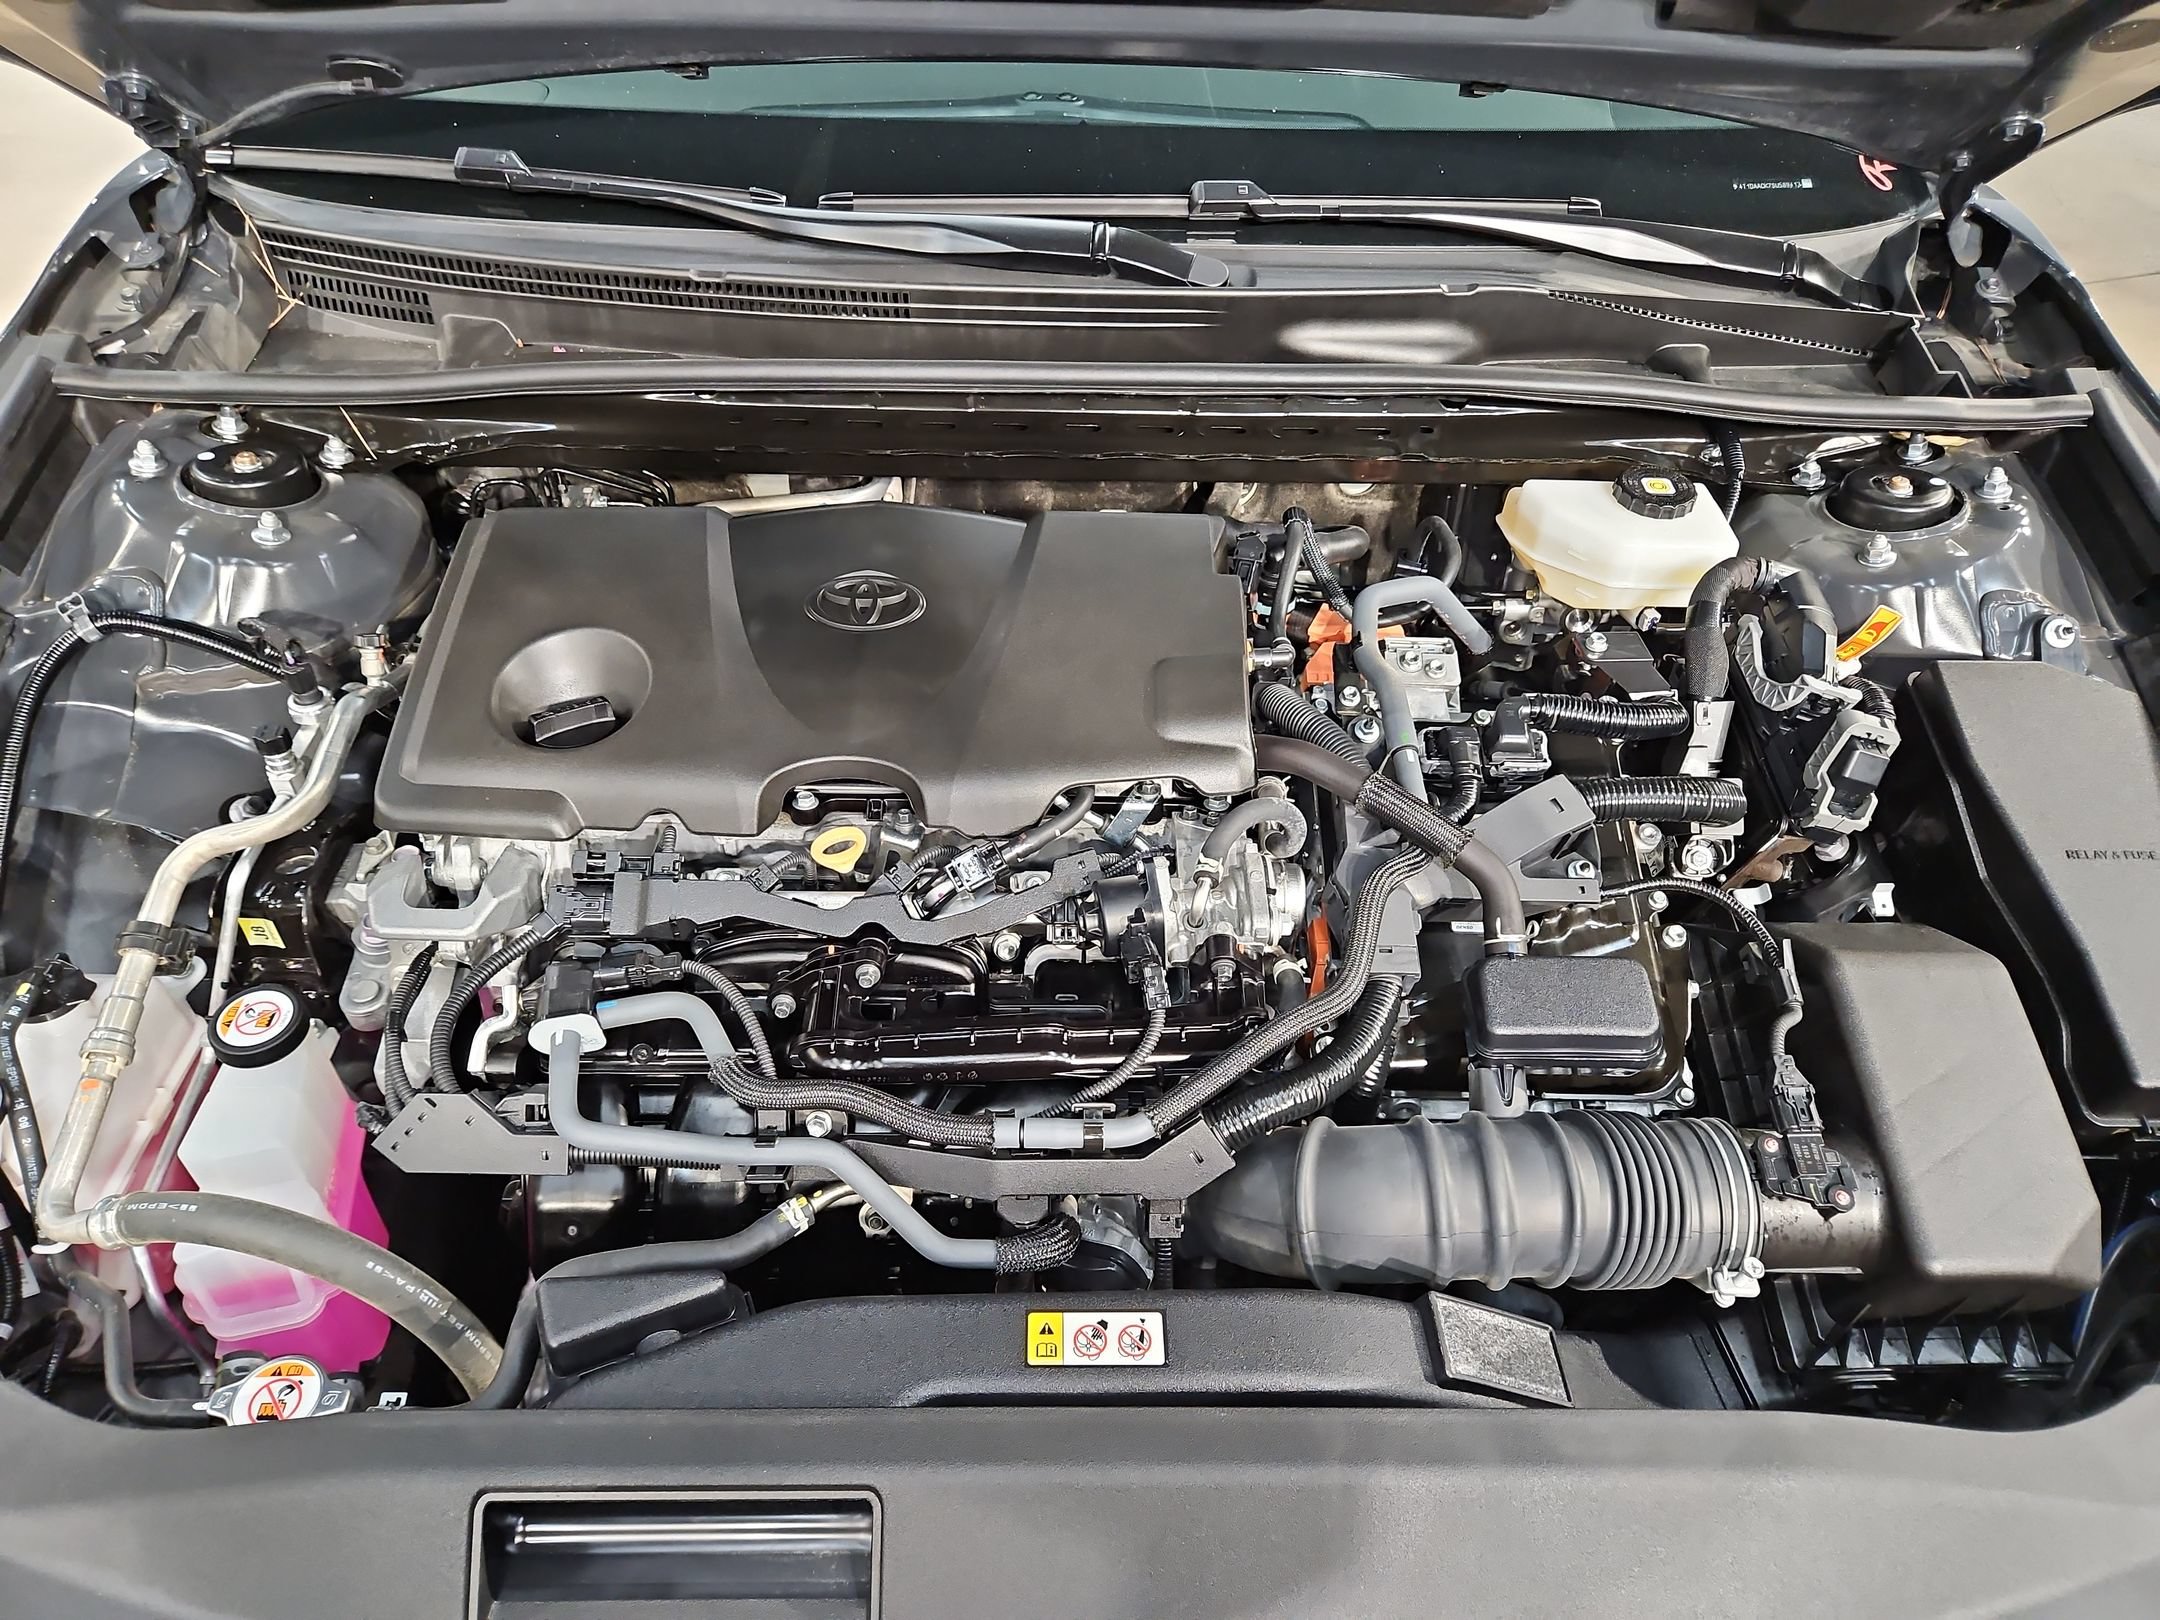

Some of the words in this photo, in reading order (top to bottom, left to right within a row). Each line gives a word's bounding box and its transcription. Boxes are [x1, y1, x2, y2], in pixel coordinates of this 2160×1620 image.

[2064, 849, 2108, 860] RELAY
[2122, 850, 2157, 861] FUSE
[250, 926, 269, 941] J8
